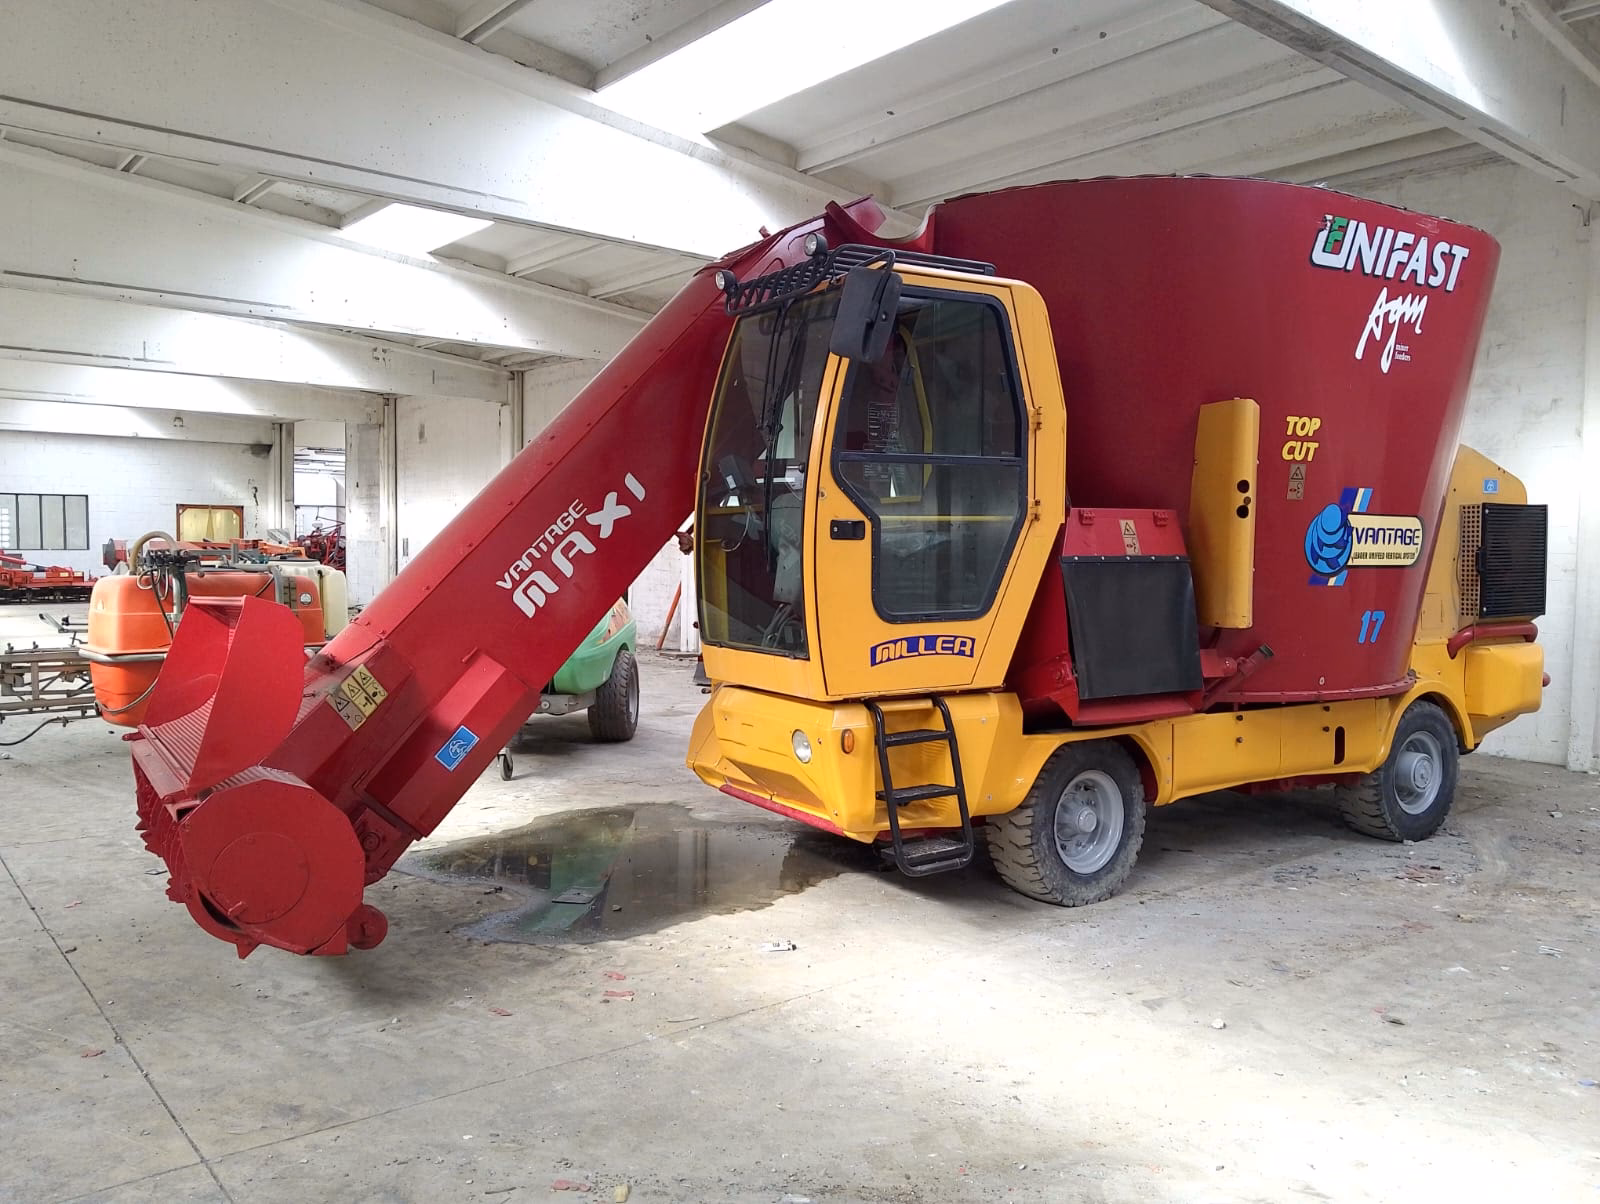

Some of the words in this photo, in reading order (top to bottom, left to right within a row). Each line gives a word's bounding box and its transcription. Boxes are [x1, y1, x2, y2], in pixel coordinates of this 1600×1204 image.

[1311, 214, 1470, 292] UNIFAST
[1286, 415, 1321, 437] TOP
[1282, 440, 1320, 462] CUT
[495, 498, 588, 590] VANTAGE
[512, 472, 646, 619] MAXI
[1355, 527, 1421, 546] VANTAGE
[1358, 610, 1385, 643] 17
[875, 636, 973, 664] MILLER
